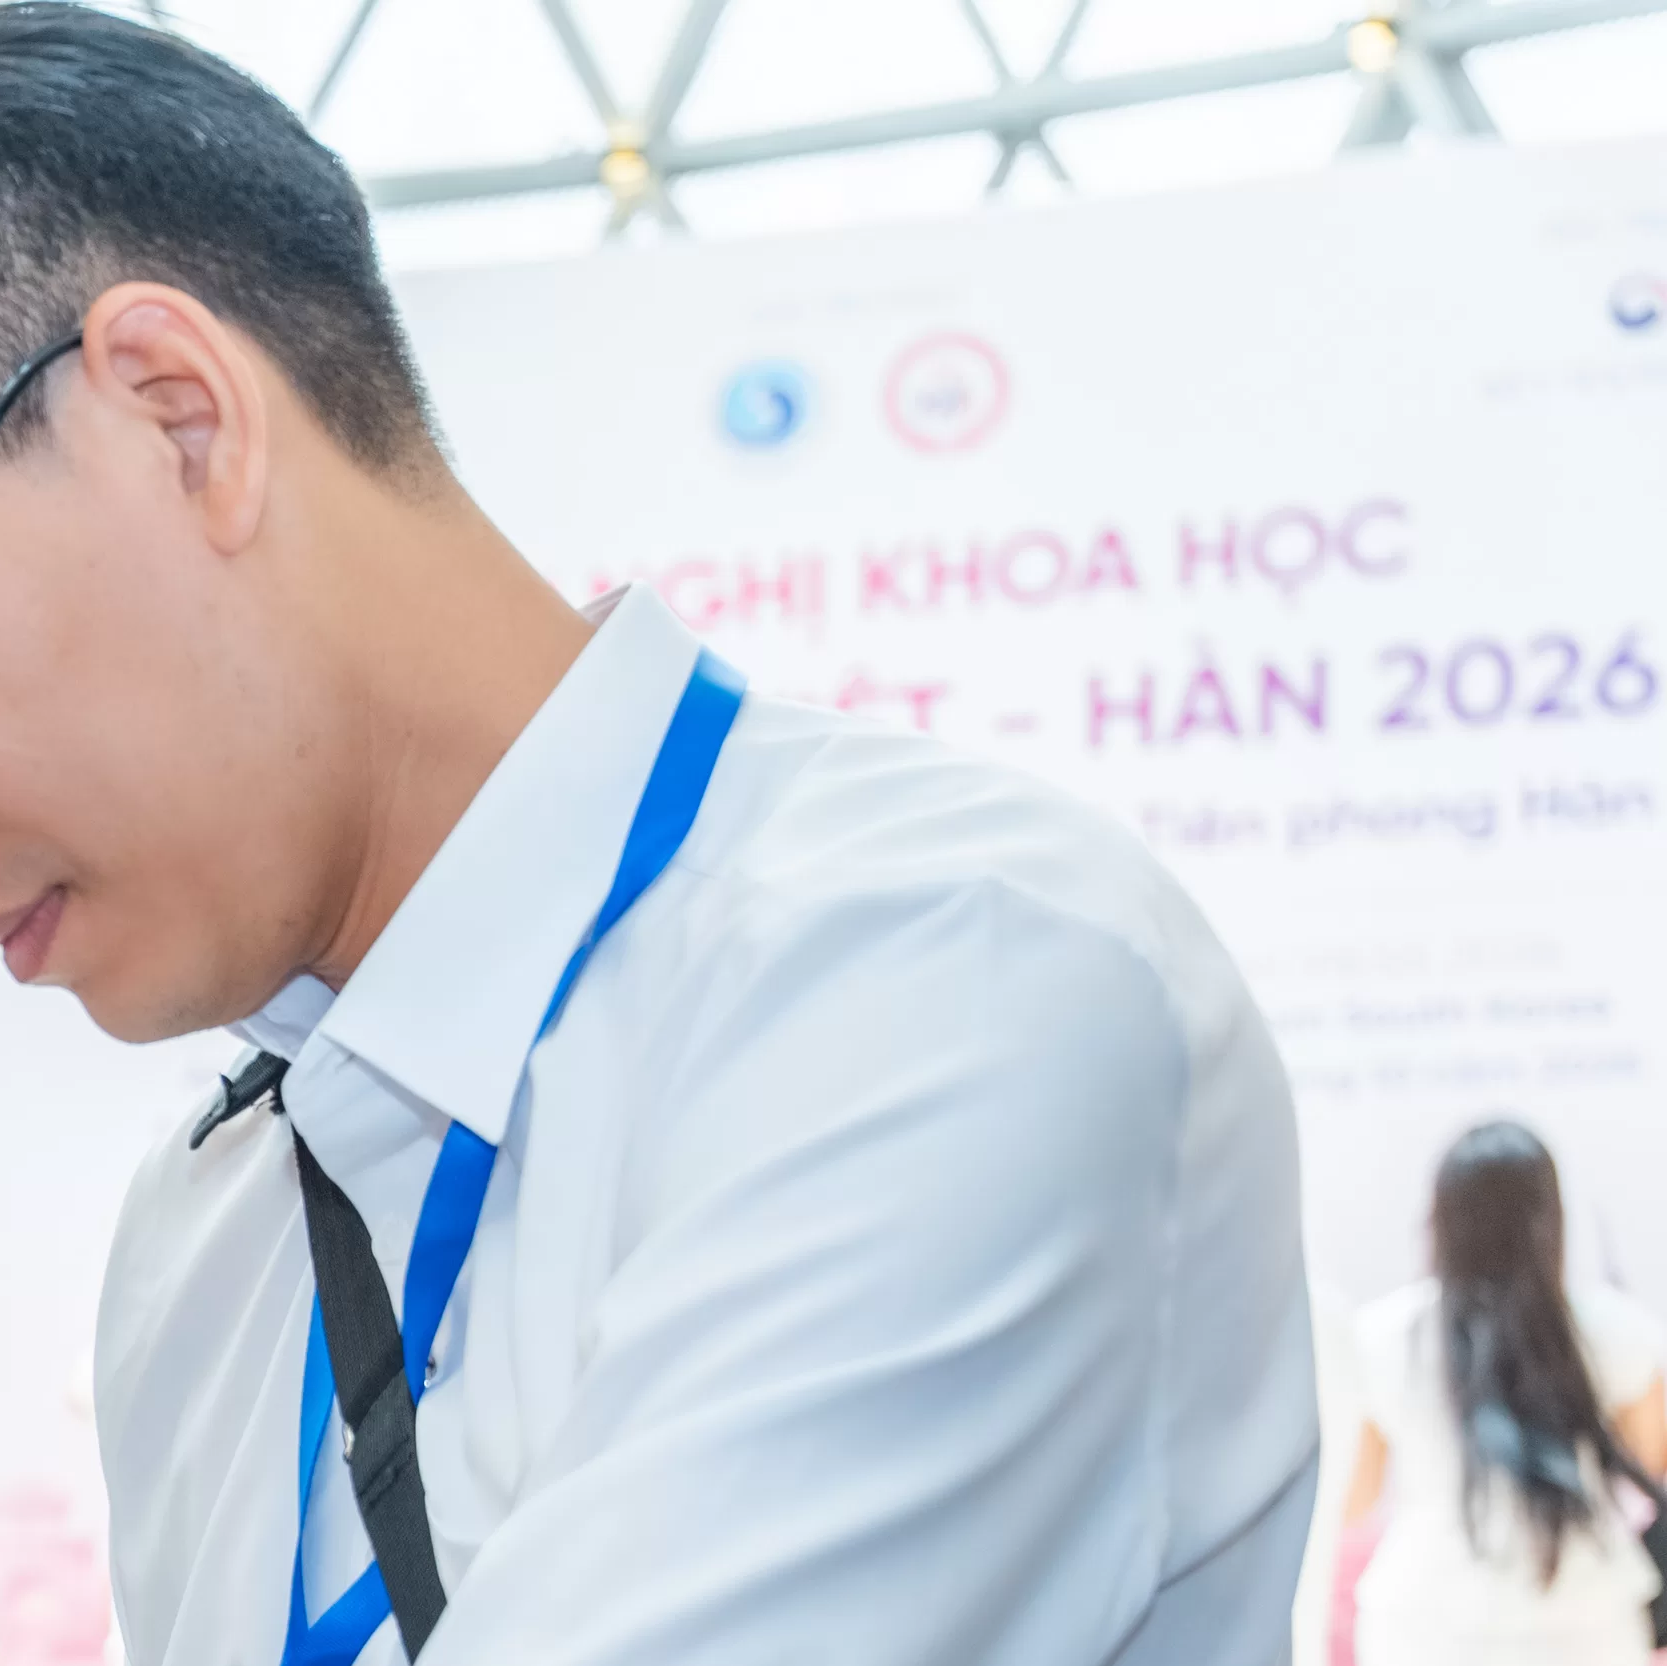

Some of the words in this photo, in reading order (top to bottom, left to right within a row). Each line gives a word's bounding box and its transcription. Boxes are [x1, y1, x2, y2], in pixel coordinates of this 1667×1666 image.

[859, 526, 1140, 610] KHOA
[1177, 496, 1410, 608] HỌC
[1086, 632, 1329, 752] HÀN
[1375, 618, 1658, 732] 2026
